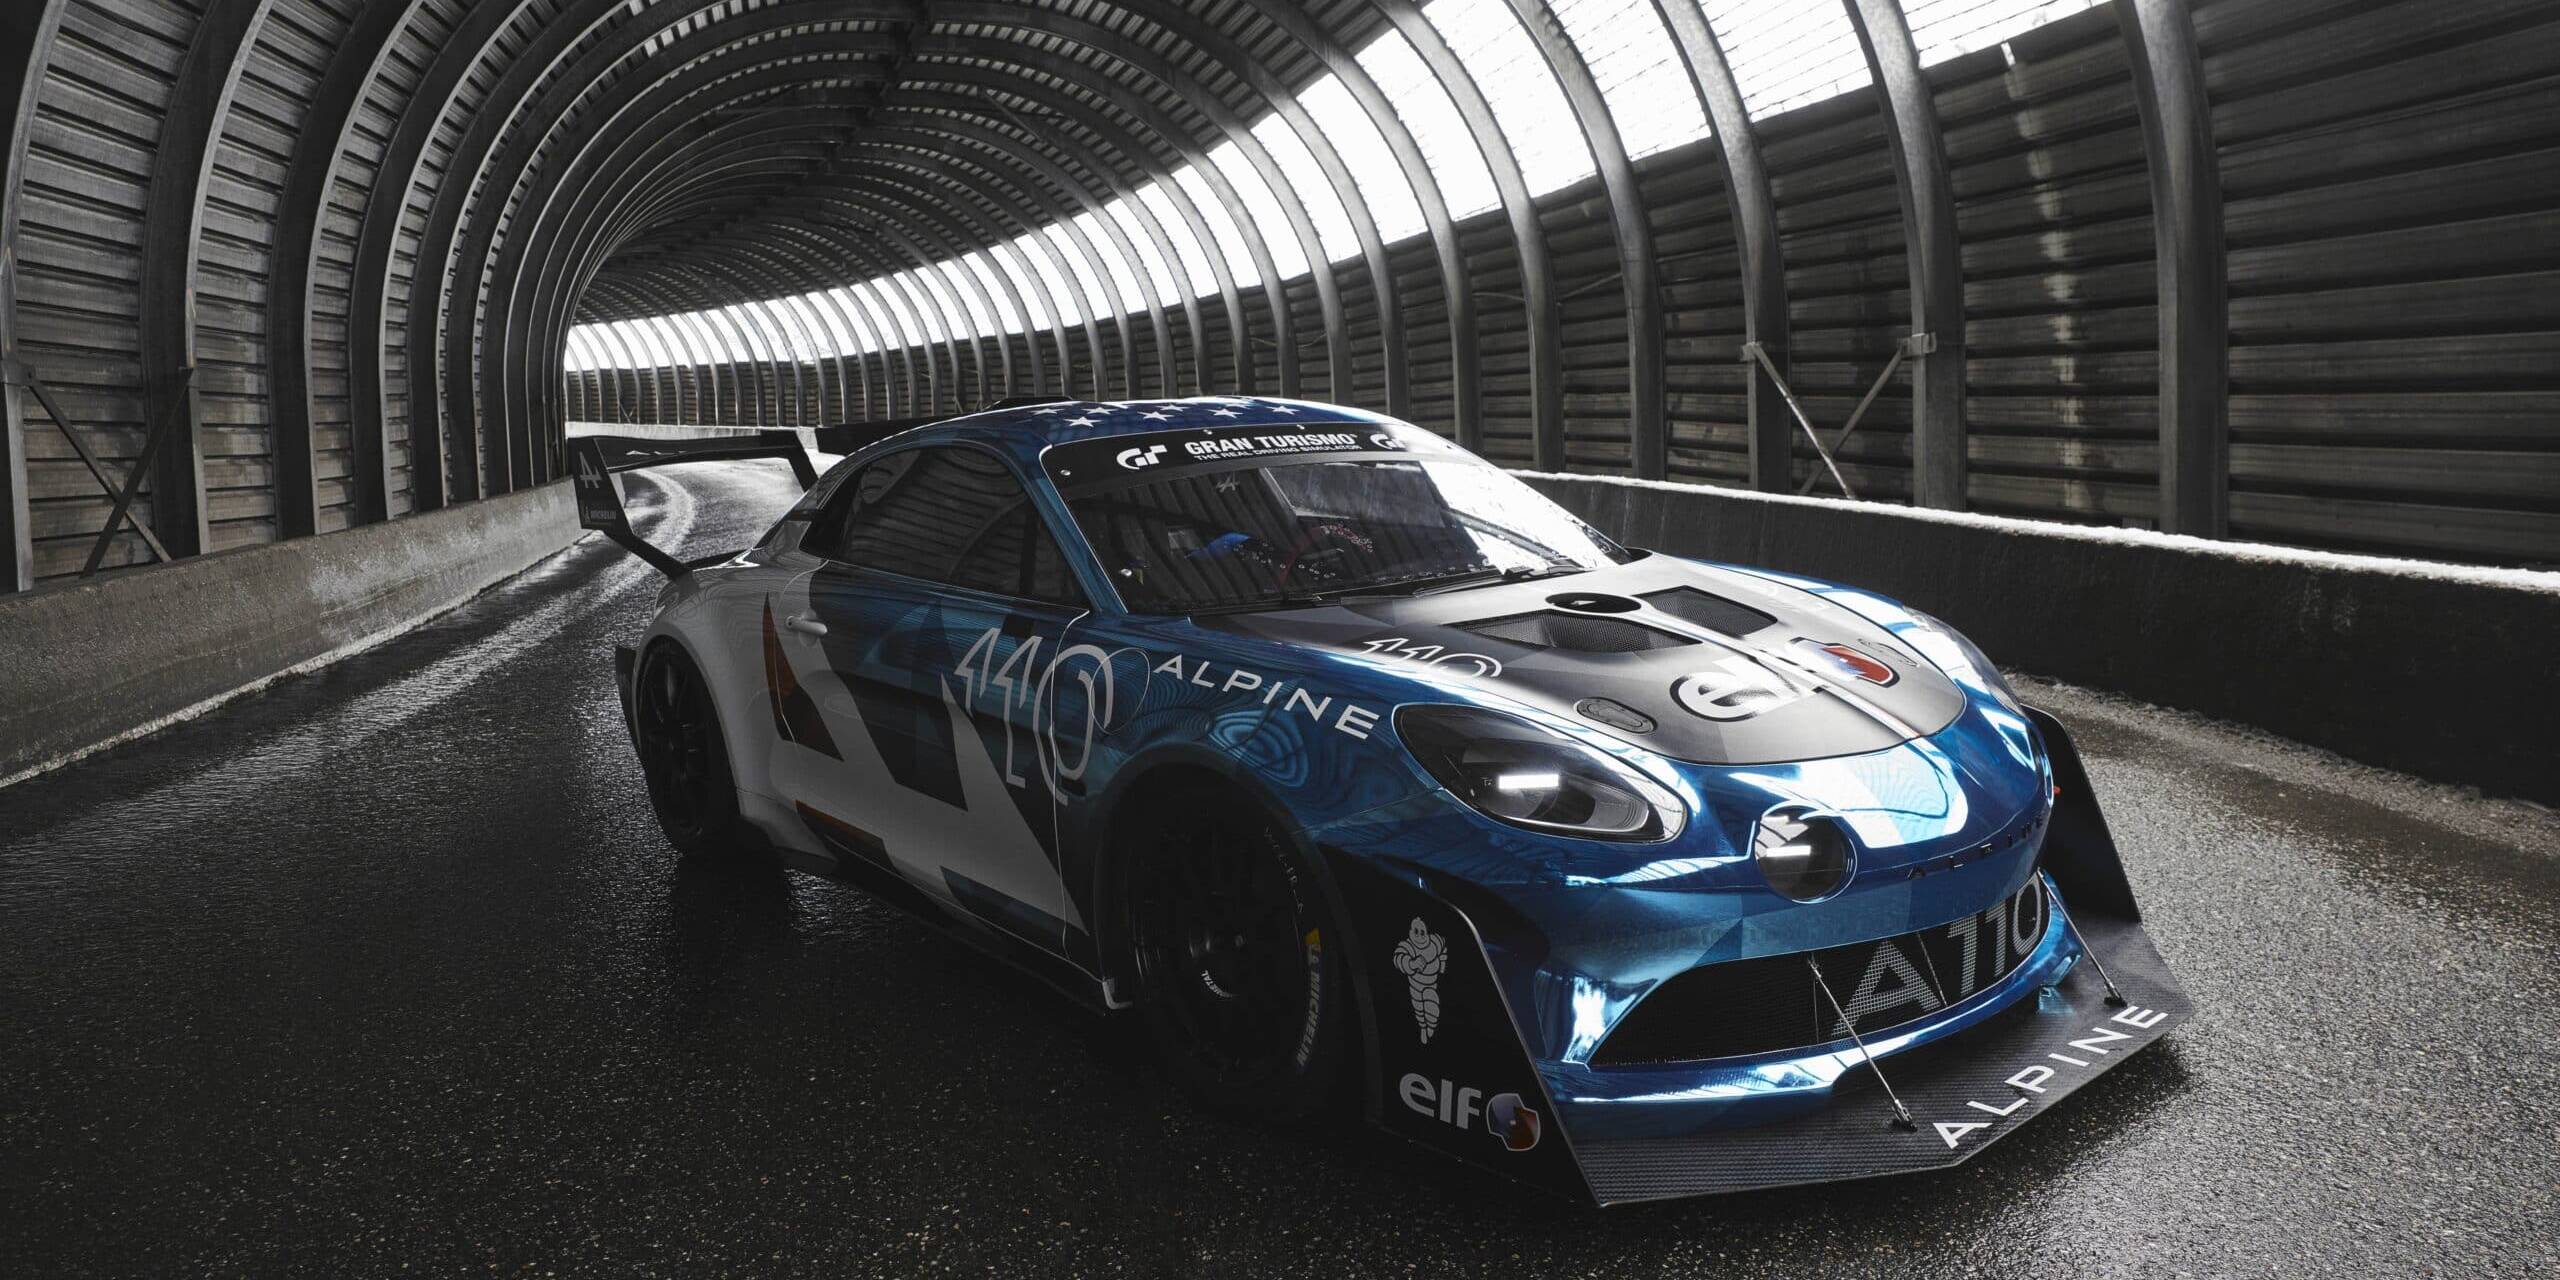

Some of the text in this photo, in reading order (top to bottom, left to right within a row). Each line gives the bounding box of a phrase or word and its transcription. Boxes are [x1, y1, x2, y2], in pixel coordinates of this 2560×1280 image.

[1184, 434, 1351, 455] GRAN TURISMO
[1220, 451, 1253, 459] REAL
[1252, 447, 1300, 456] DRIVING
[1299, 445, 1363, 453] SIMULATOR
[1154, 652, 1380, 740] ALPINE
[1831, 872, 2042, 1037] A110
[1296, 972, 1321, 1067] MICHELIN
[1400, 1072, 1482, 1129] elf
[1932, 1005, 2169, 1150] ALPINE
